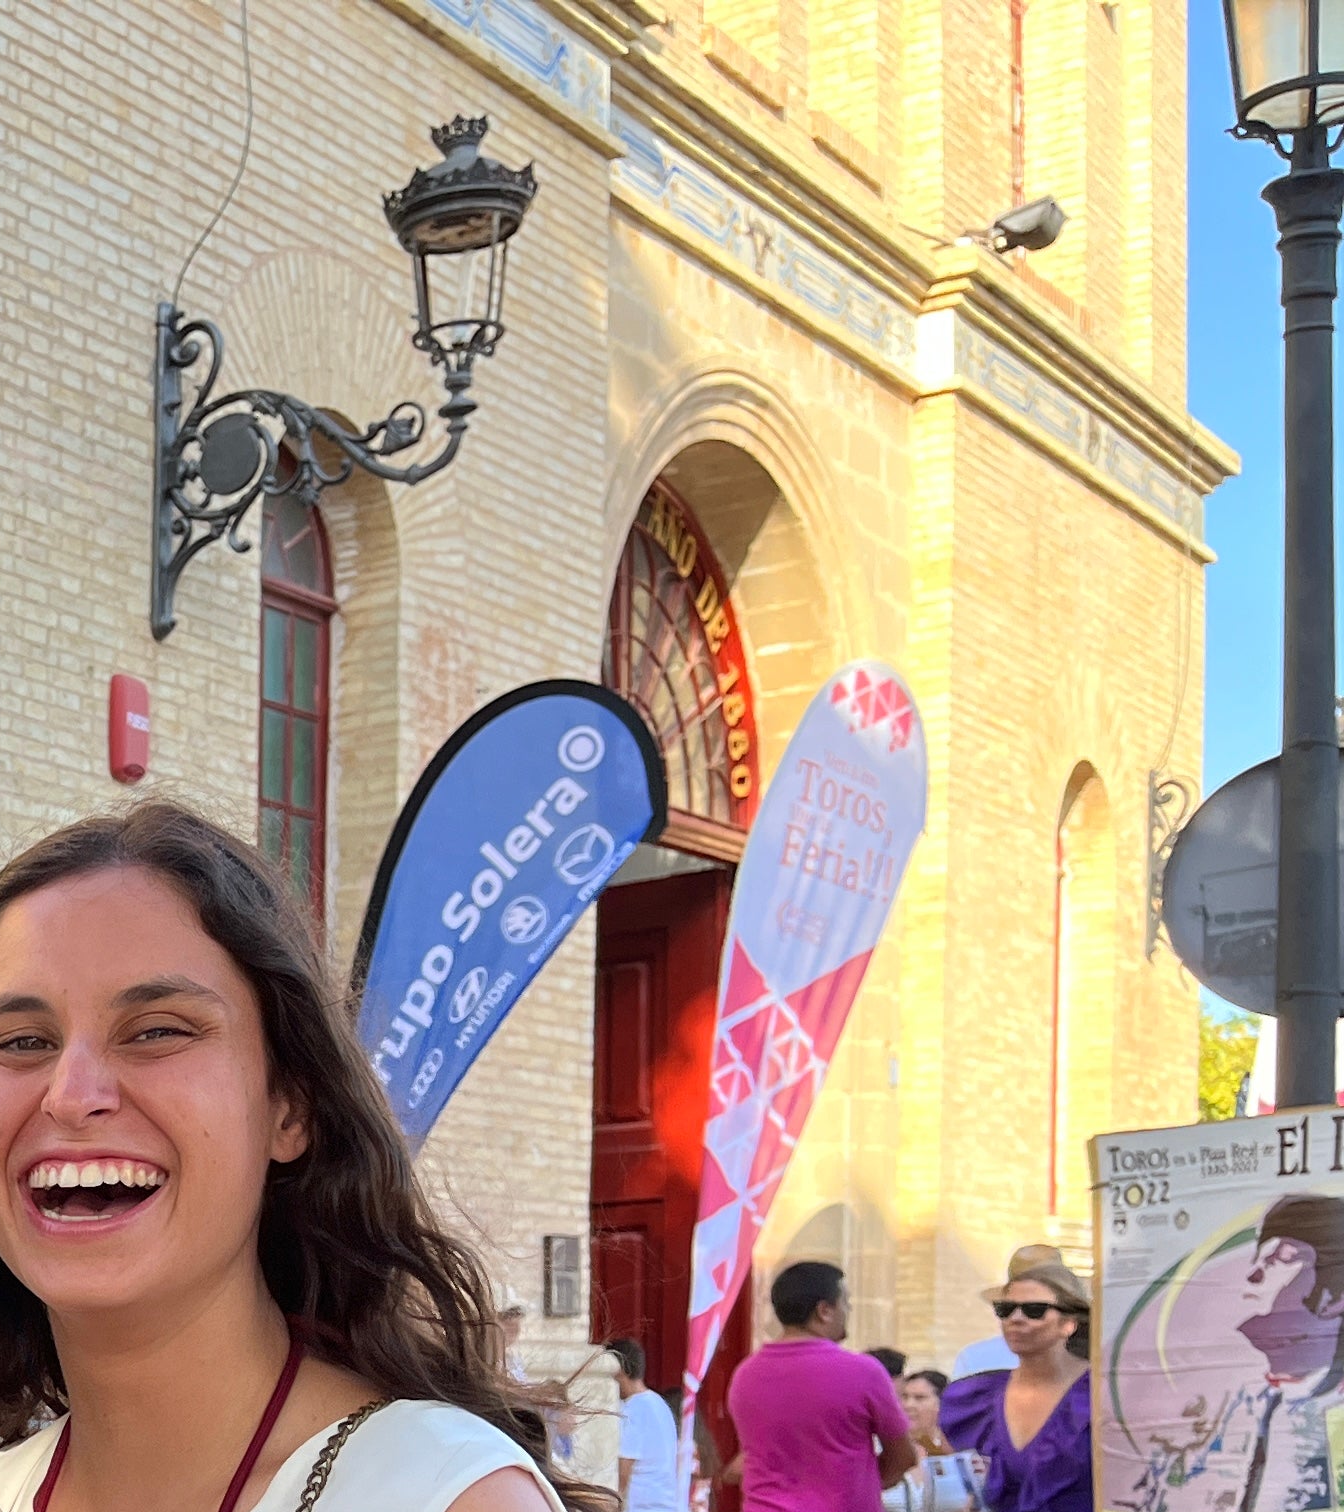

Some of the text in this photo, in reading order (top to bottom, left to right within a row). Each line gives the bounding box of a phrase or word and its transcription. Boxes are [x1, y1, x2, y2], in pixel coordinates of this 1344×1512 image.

[695, 574, 730, 656] DE
[717, 661, 751, 800] 1880
[794, 757, 893, 849] Toros,
[780, 823, 895, 904] Feria!!!
[371, 776, 588, 1086] rupo Solera
[1110, 1180, 1171, 1208] 2022
